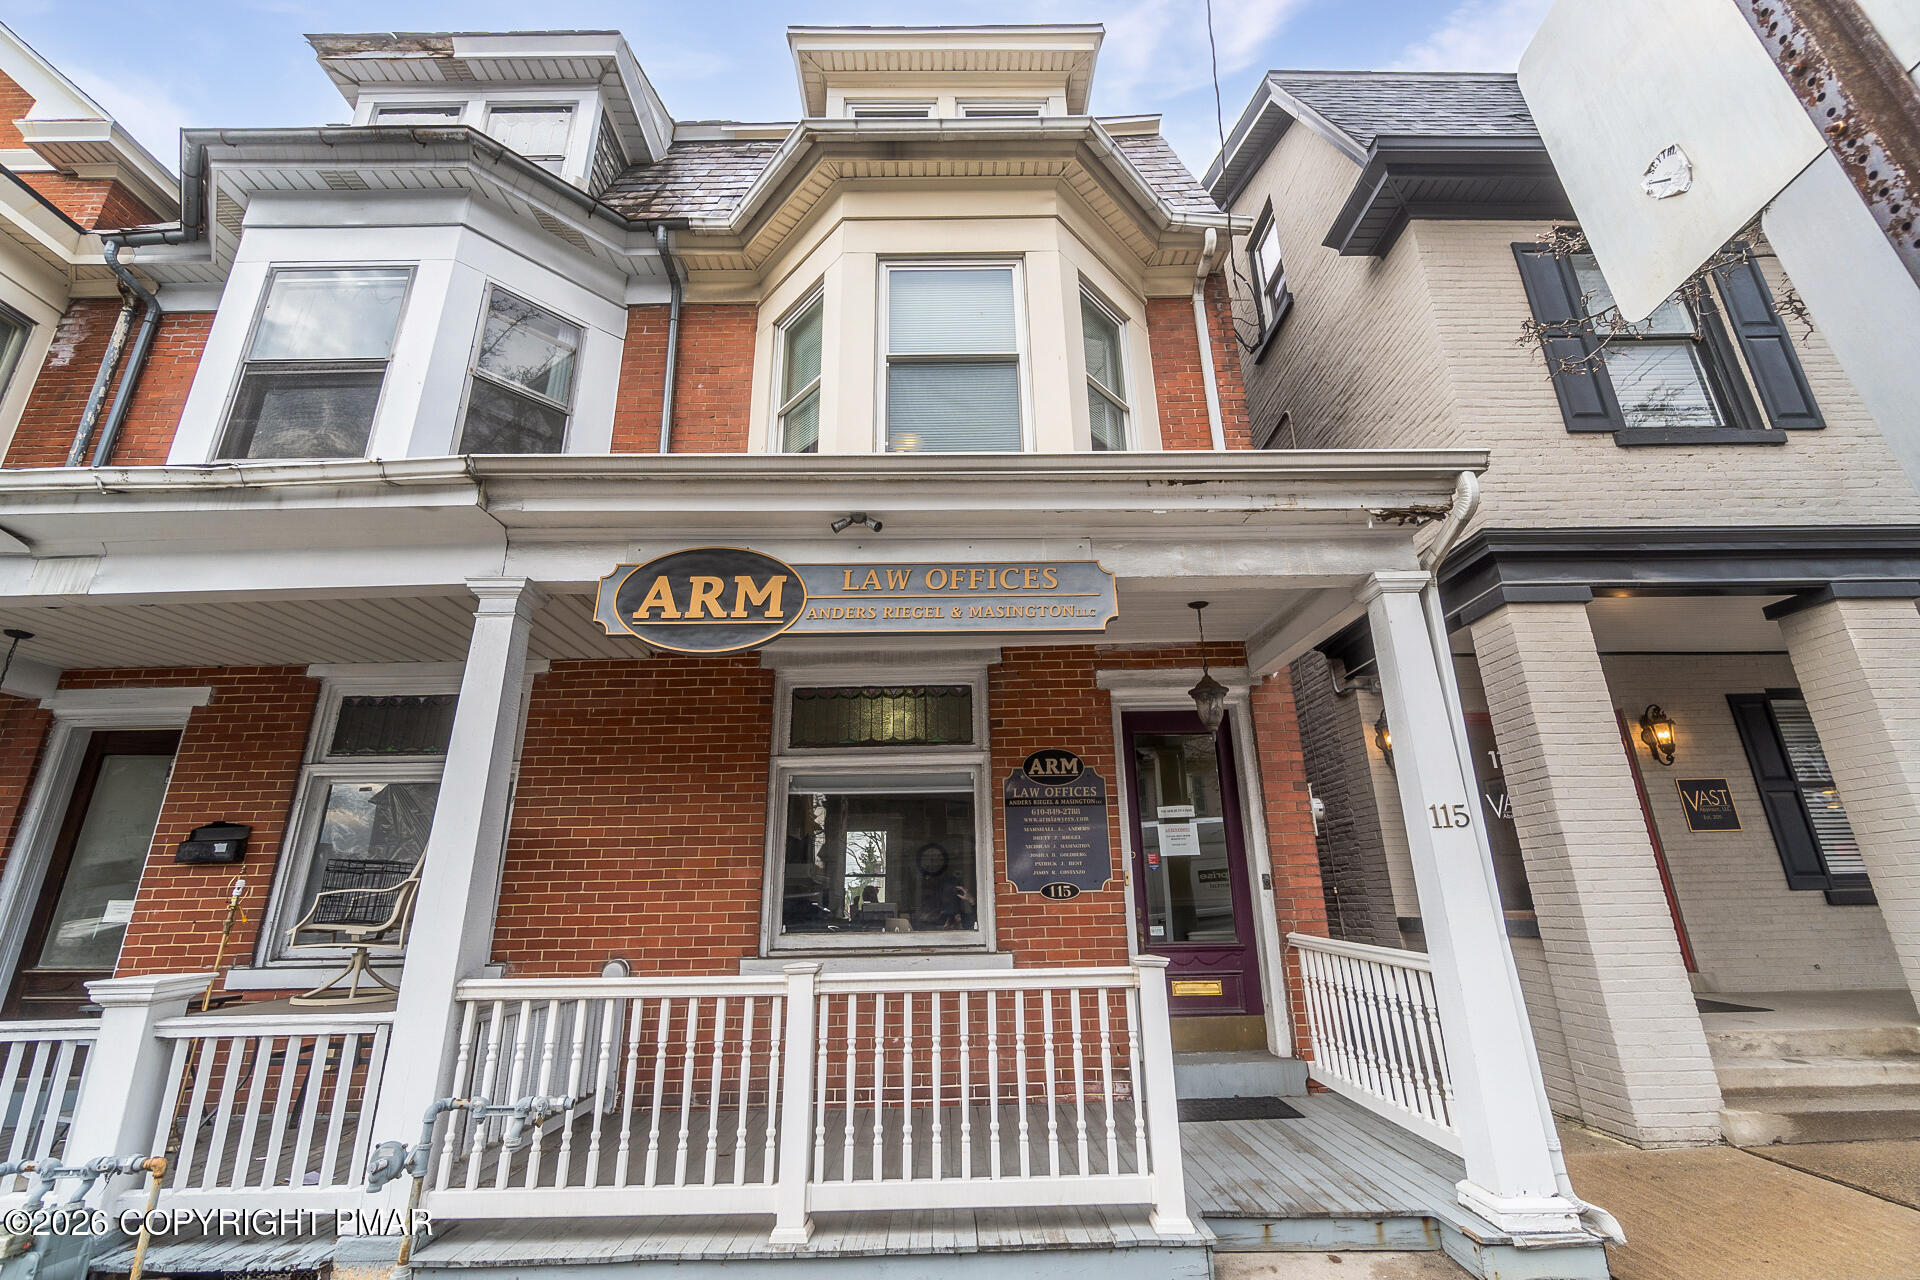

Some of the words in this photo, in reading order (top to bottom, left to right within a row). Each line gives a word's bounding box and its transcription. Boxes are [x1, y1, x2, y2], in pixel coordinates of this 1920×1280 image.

[842, 569, 912, 591] LAW
[925, 567, 1058, 590] OFFICES
[632, 575, 787, 619] ARM
[806, 607, 876, 620] ANDERS
[883, 606, 945, 619] RIEGEL
[951, 606, 963, 619] &
[1028, 757, 1079, 775] ARM
[1013, 787, 1040, 799] LAW
[1045, 786, 1097, 798] OFFICES
[1683, 789, 1727, 812] VAST
[1429, 803, 1470, 829] 115
[1050, 885, 1072, 898] 115
